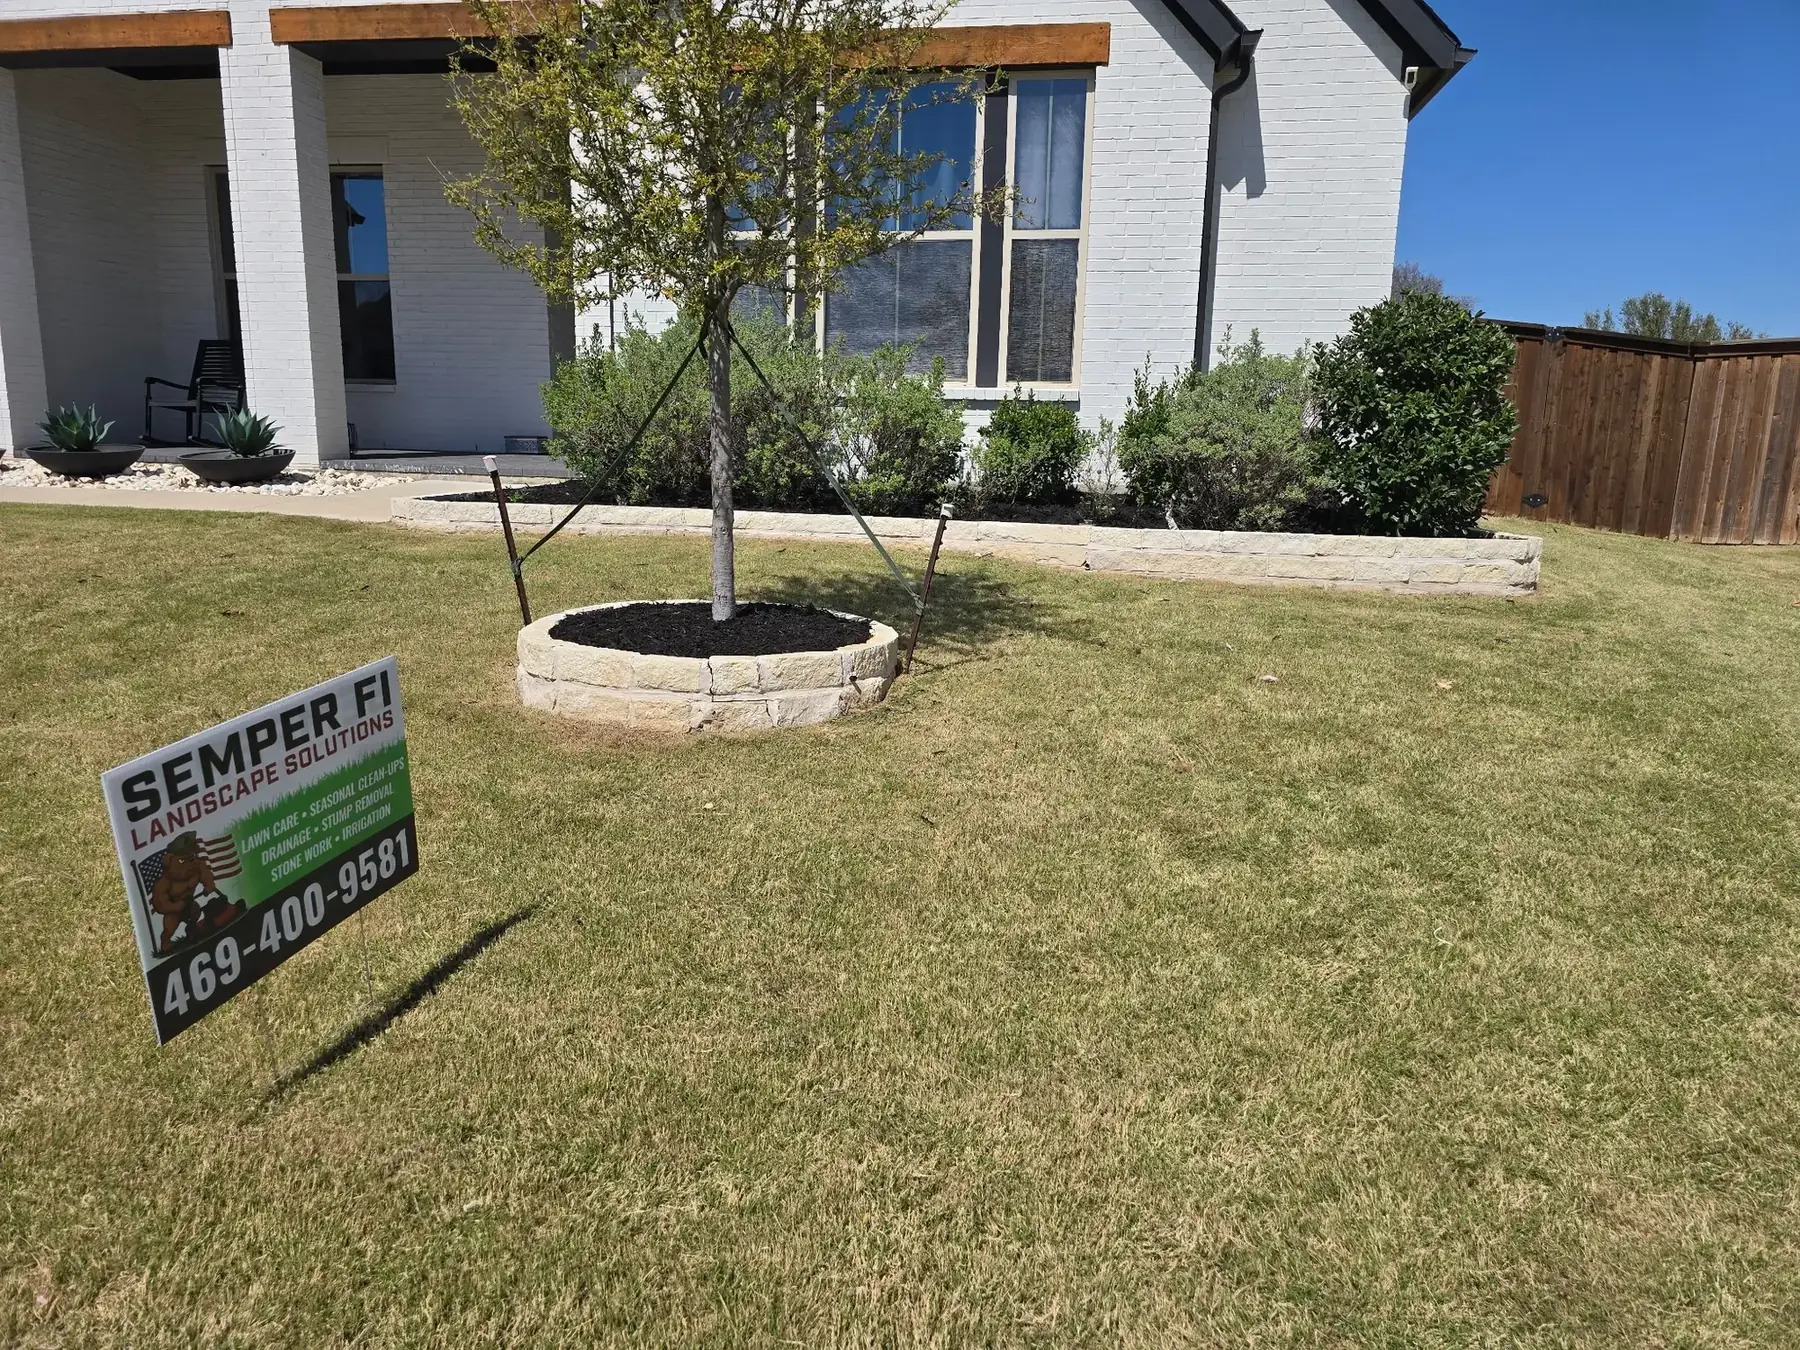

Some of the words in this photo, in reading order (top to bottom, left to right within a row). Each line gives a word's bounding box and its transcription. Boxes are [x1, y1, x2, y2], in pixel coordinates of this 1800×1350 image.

[121, 692, 342, 823] SEMPER
[353, 669, 392, 719] FI
[131, 762, 279, 851] LANDSCAPE
[285, 709, 394, 776] SOLUTIONS
[241, 826, 271, 854] LAWN
[273, 811, 300, 836] CARE
[310, 786, 356, 816] SEASONAL
[357, 757, 405, 791] CLEAN-UPS
[261, 826, 312, 867] DRAINAGE
[321, 806, 353, 832] STUMP
[355, 782, 394, 811] REMOVAL
[271, 857, 302, 882] STONE
[304, 835, 332, 862] WORK
[342, 802, 392, 841] IRRIGATION
[163, 828, 411, 1016] 469-400-9581
